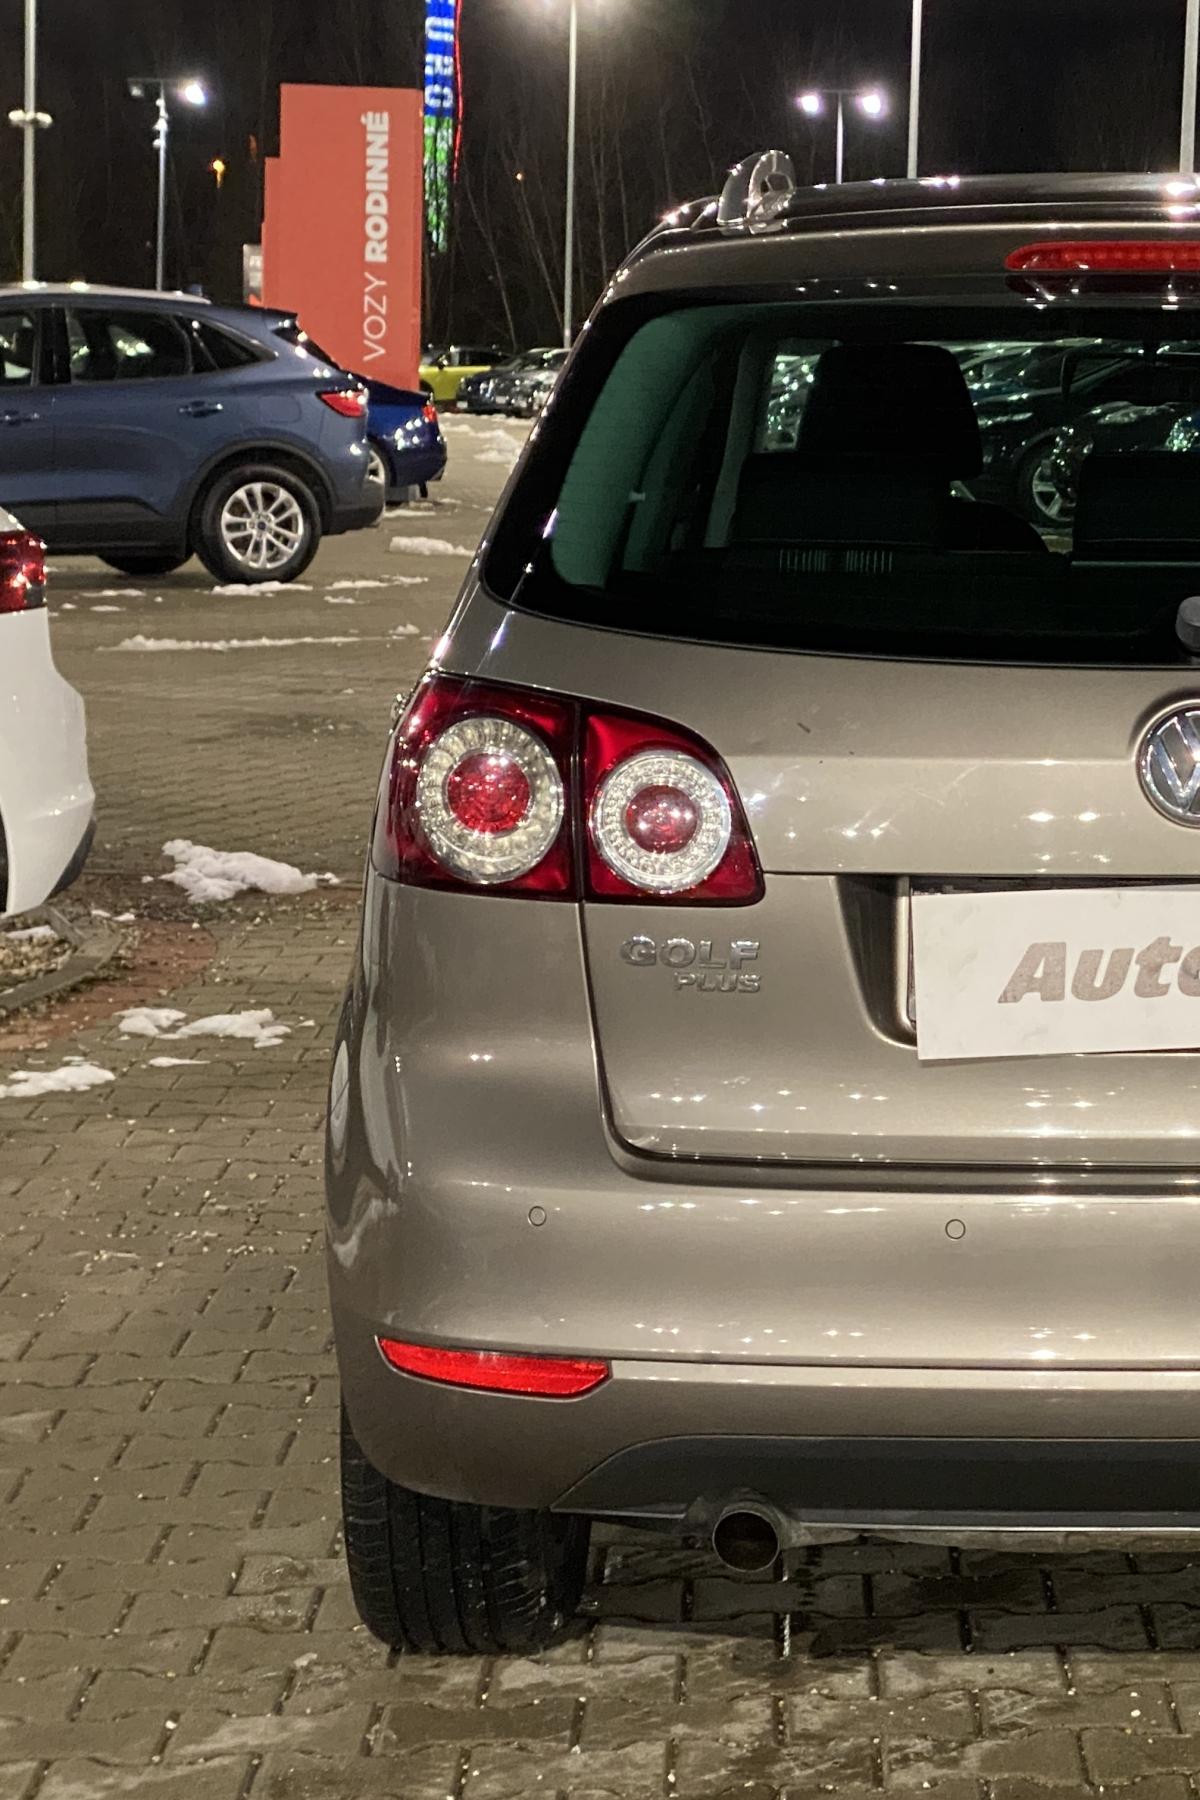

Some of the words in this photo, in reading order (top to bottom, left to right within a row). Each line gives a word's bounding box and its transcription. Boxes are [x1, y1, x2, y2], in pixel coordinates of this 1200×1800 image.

[360, 111, 389, 263] RODINNÉ
[364, 272, 387, 362] VOZY
[620, 935, 760, 969] GOLF
[674, 972, 761, 993] PLUS
